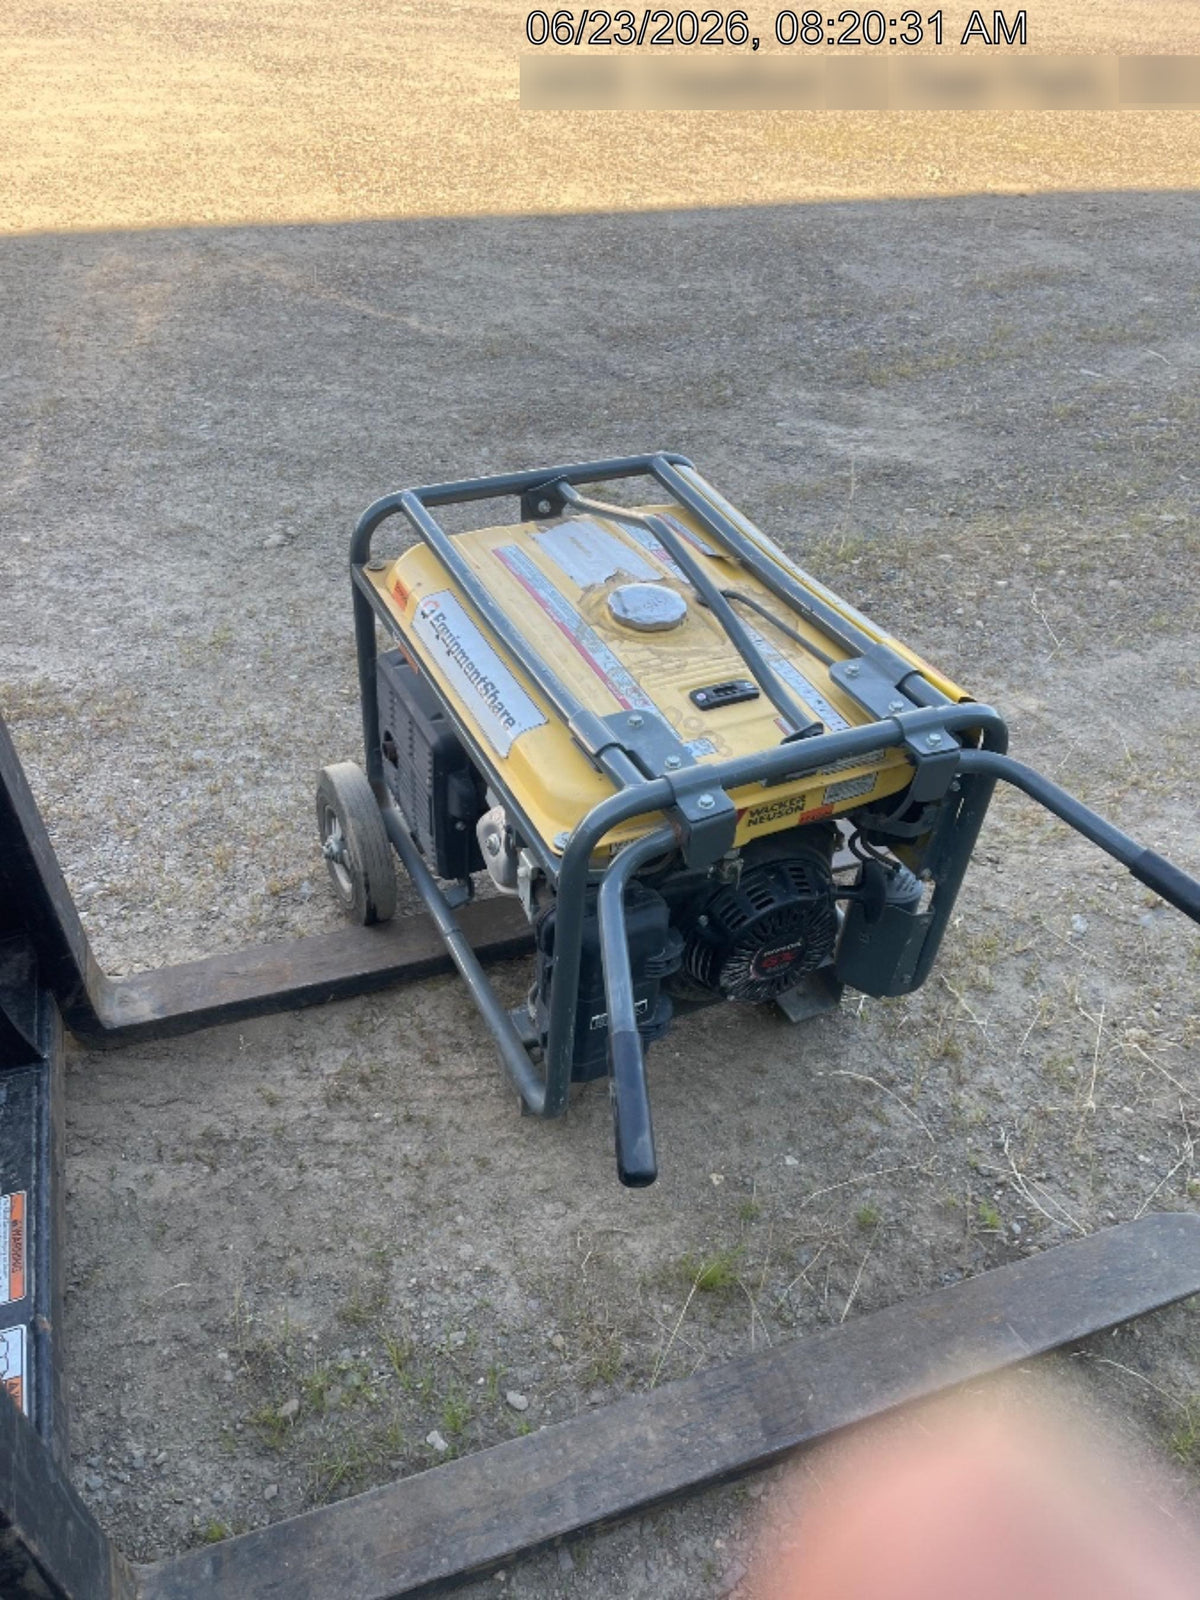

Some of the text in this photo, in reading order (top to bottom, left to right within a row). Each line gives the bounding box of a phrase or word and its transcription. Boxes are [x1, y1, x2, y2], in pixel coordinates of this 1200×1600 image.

[429, 611, 517, 730] EquipmentShare
[747, 802, 805, 827] NEUSON
[749, 794, 806, 817] WACKER
